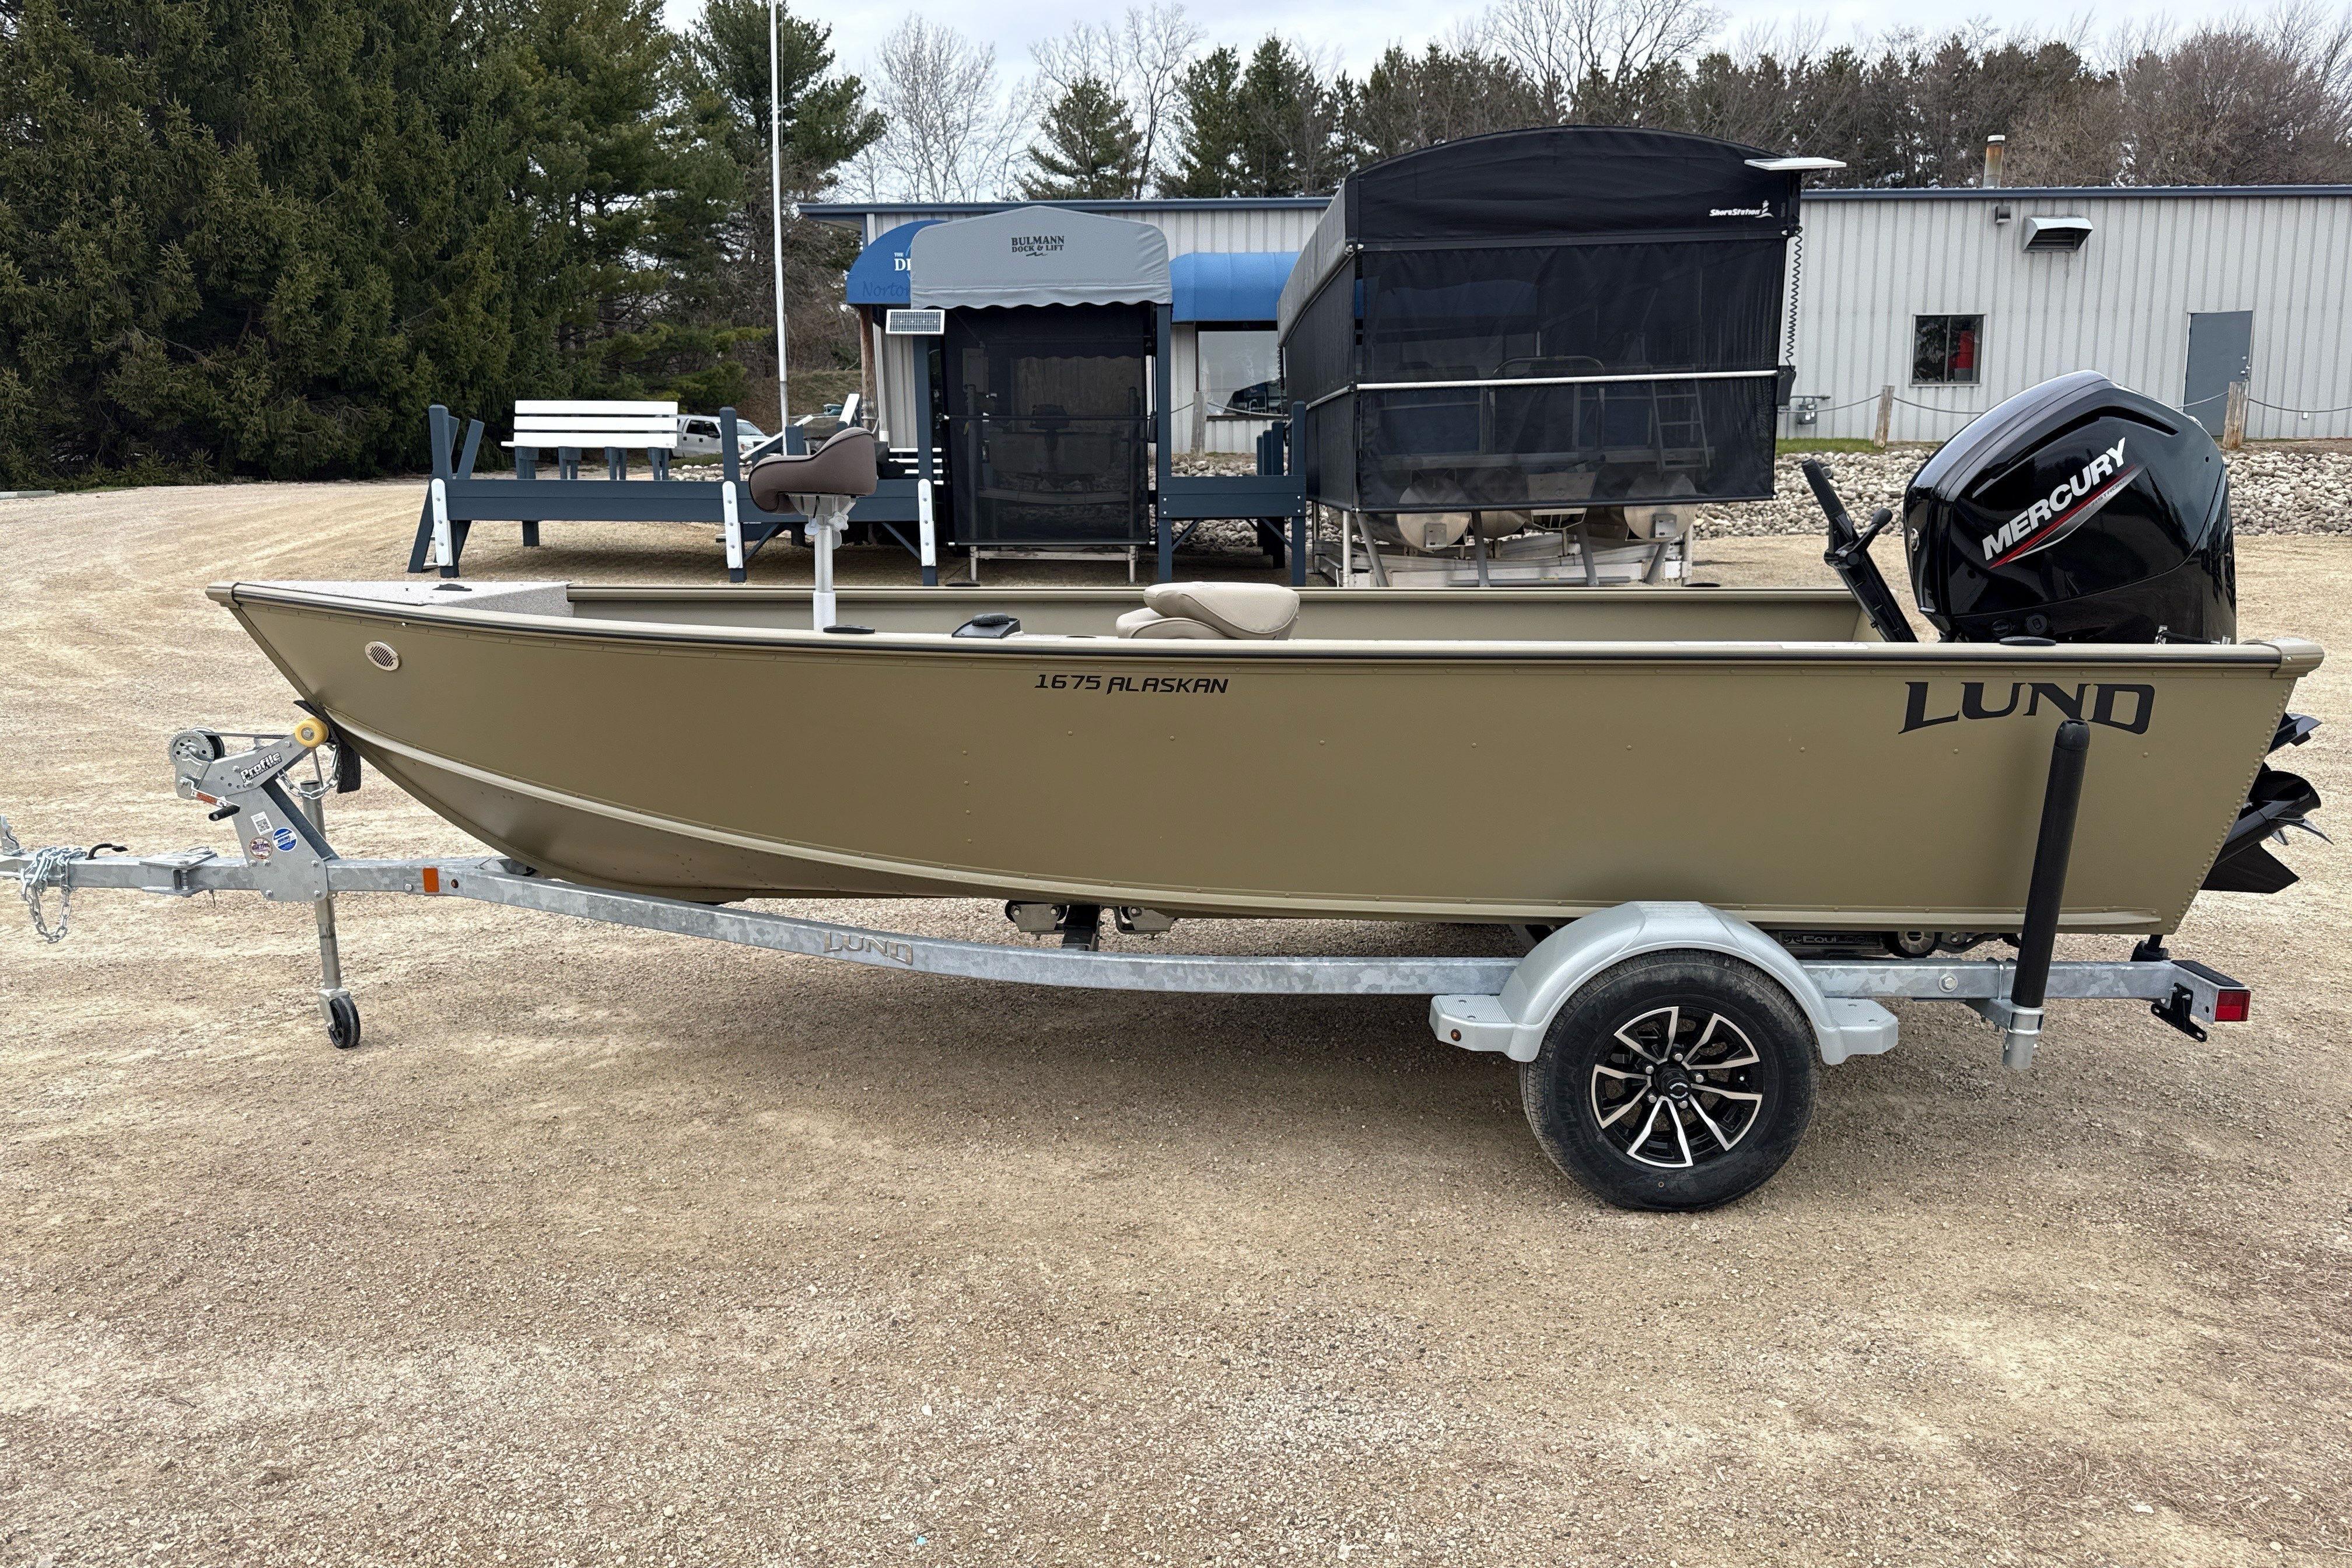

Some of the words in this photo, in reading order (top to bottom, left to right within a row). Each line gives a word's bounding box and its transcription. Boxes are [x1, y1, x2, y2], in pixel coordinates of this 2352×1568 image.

[1012, 236, 1064, 246] BULMANN
[1982, 437, 2126, 561] MERCURY
[1034, 674, 1102, 690] 1675
[1107, 677, 1228, 695] ALASKAN
[1898, 681, 2155, 734] LUND
[240, 752, 281, 780] Profile
[822, 930, 914, 965] LUND
